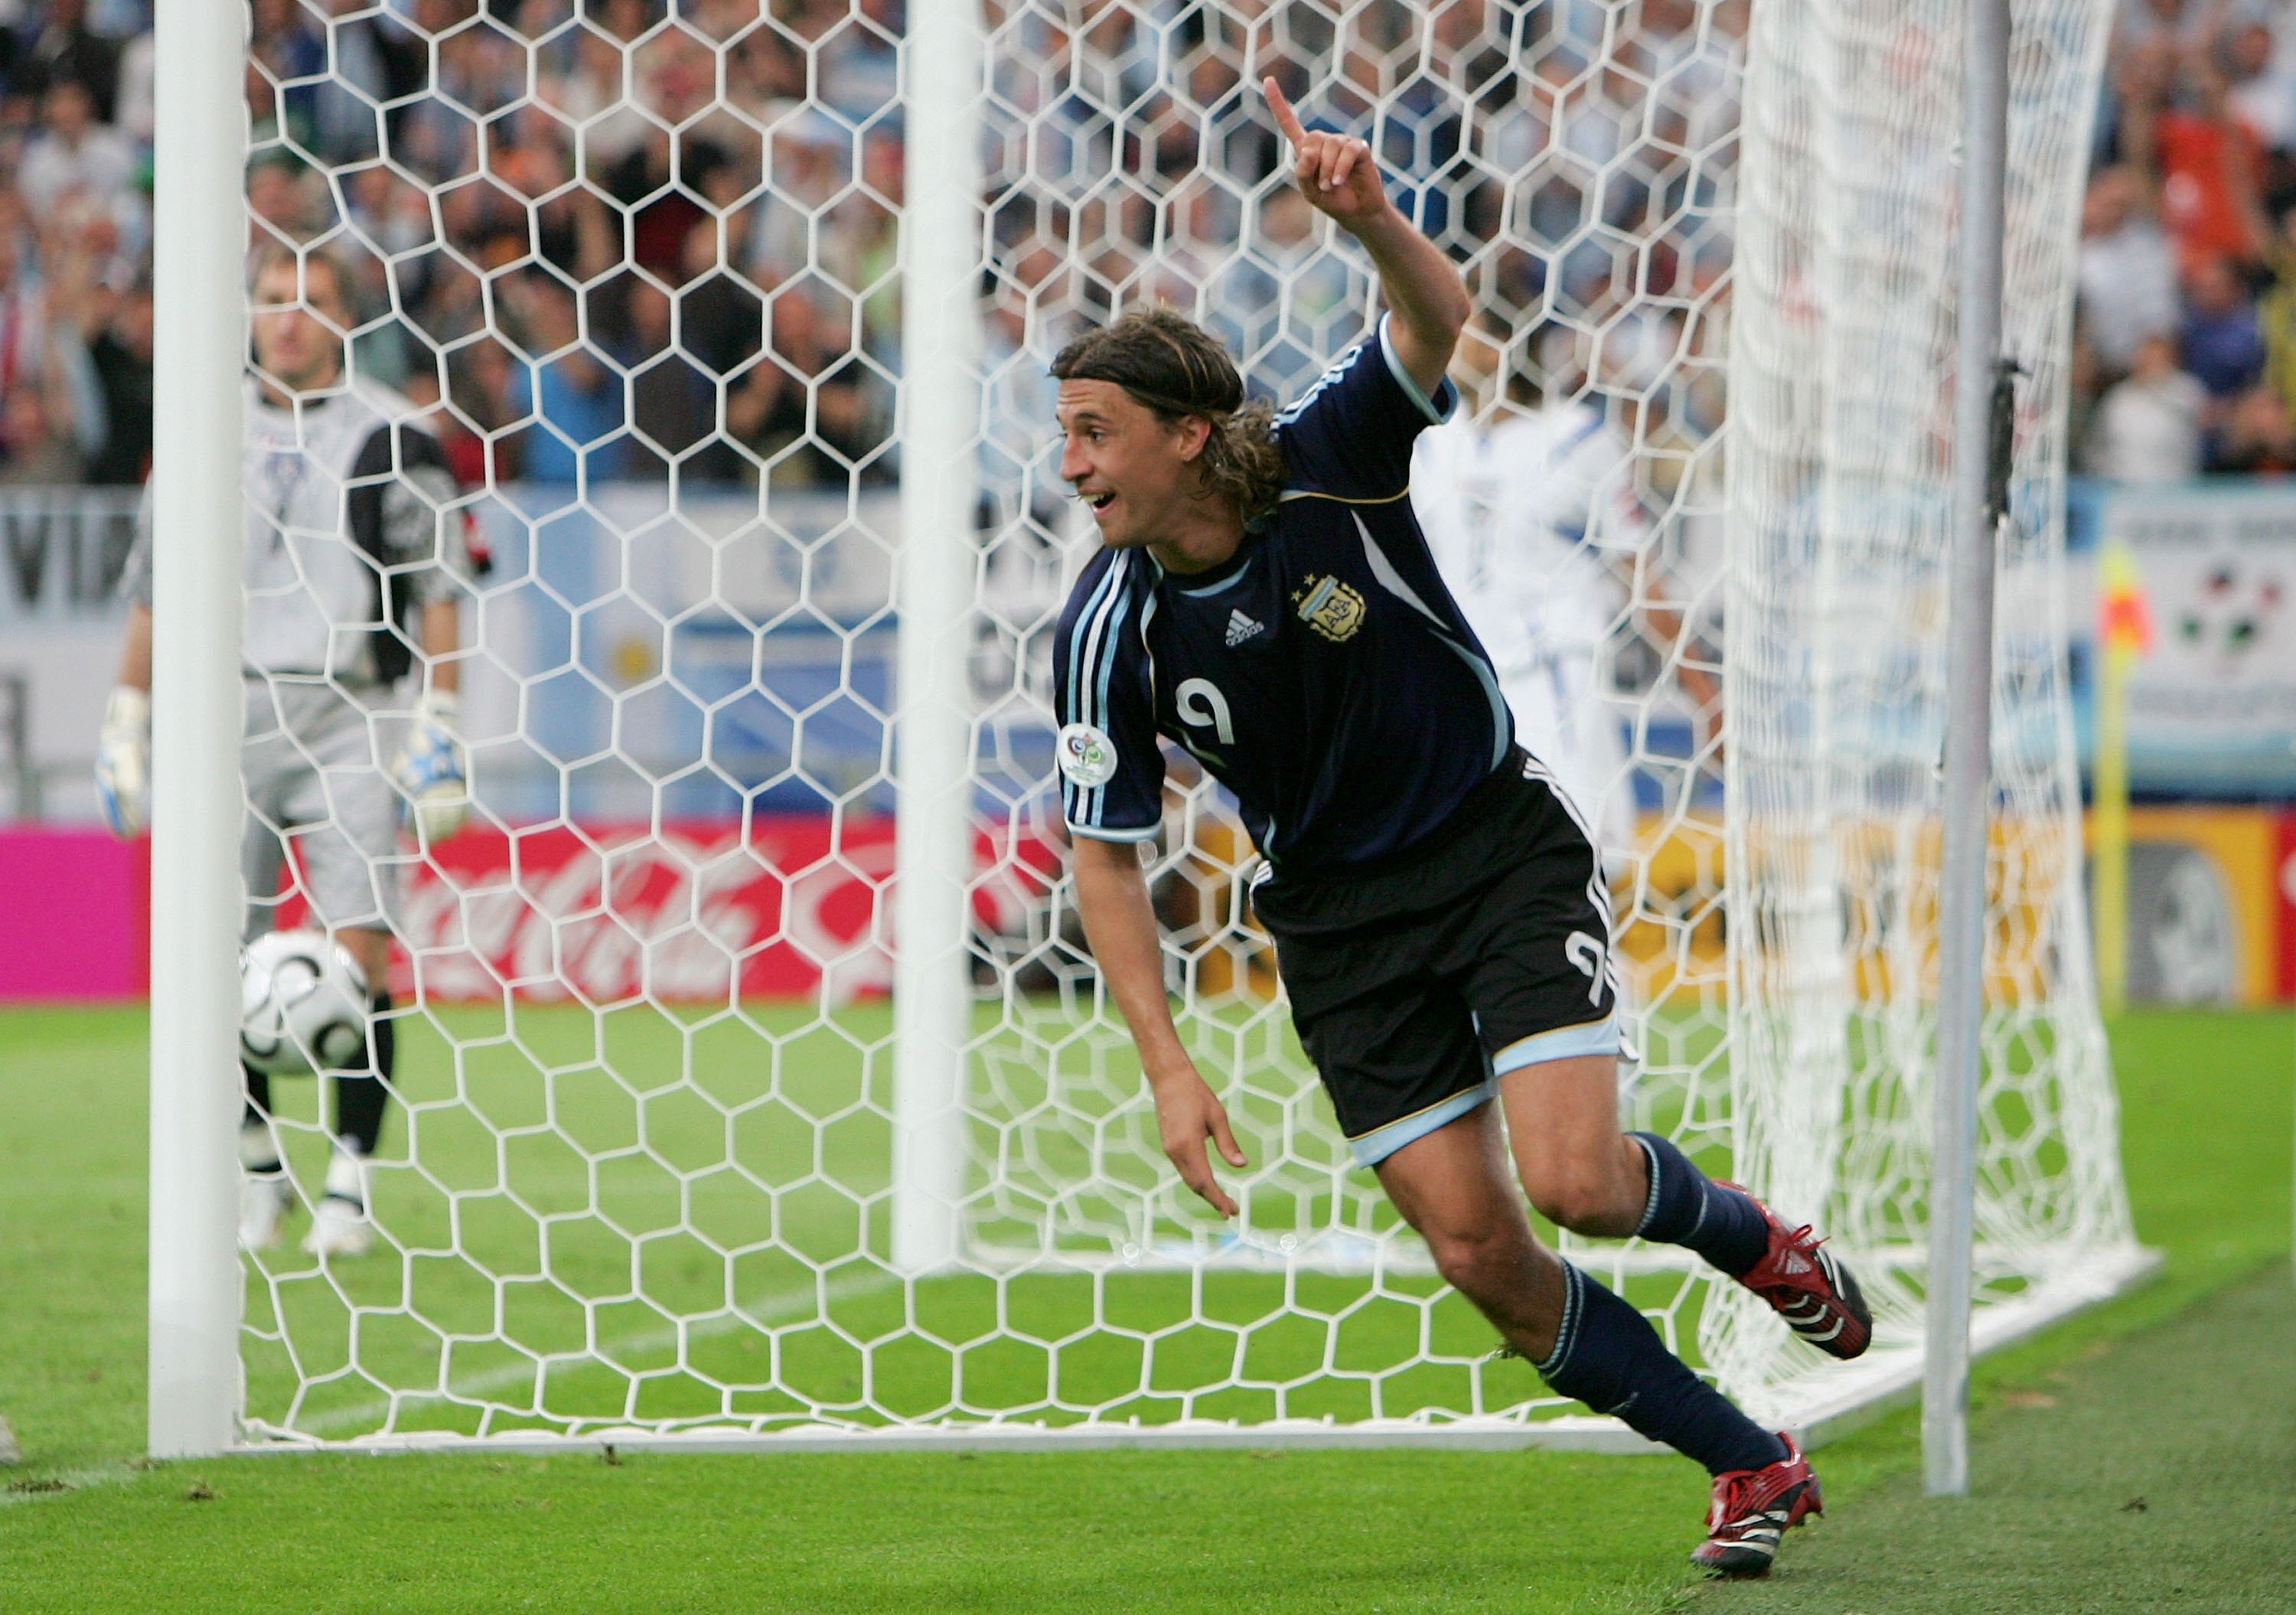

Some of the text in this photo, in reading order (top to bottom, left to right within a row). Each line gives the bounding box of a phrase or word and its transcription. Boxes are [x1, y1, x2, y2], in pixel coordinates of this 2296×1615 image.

[1225, 620, 1264, 646] adidas
[1176, 677, 1234, 745] 9
[392, 825, 773, 1001] oca-Cola
[1564, 931, 1606, 1008] 9
